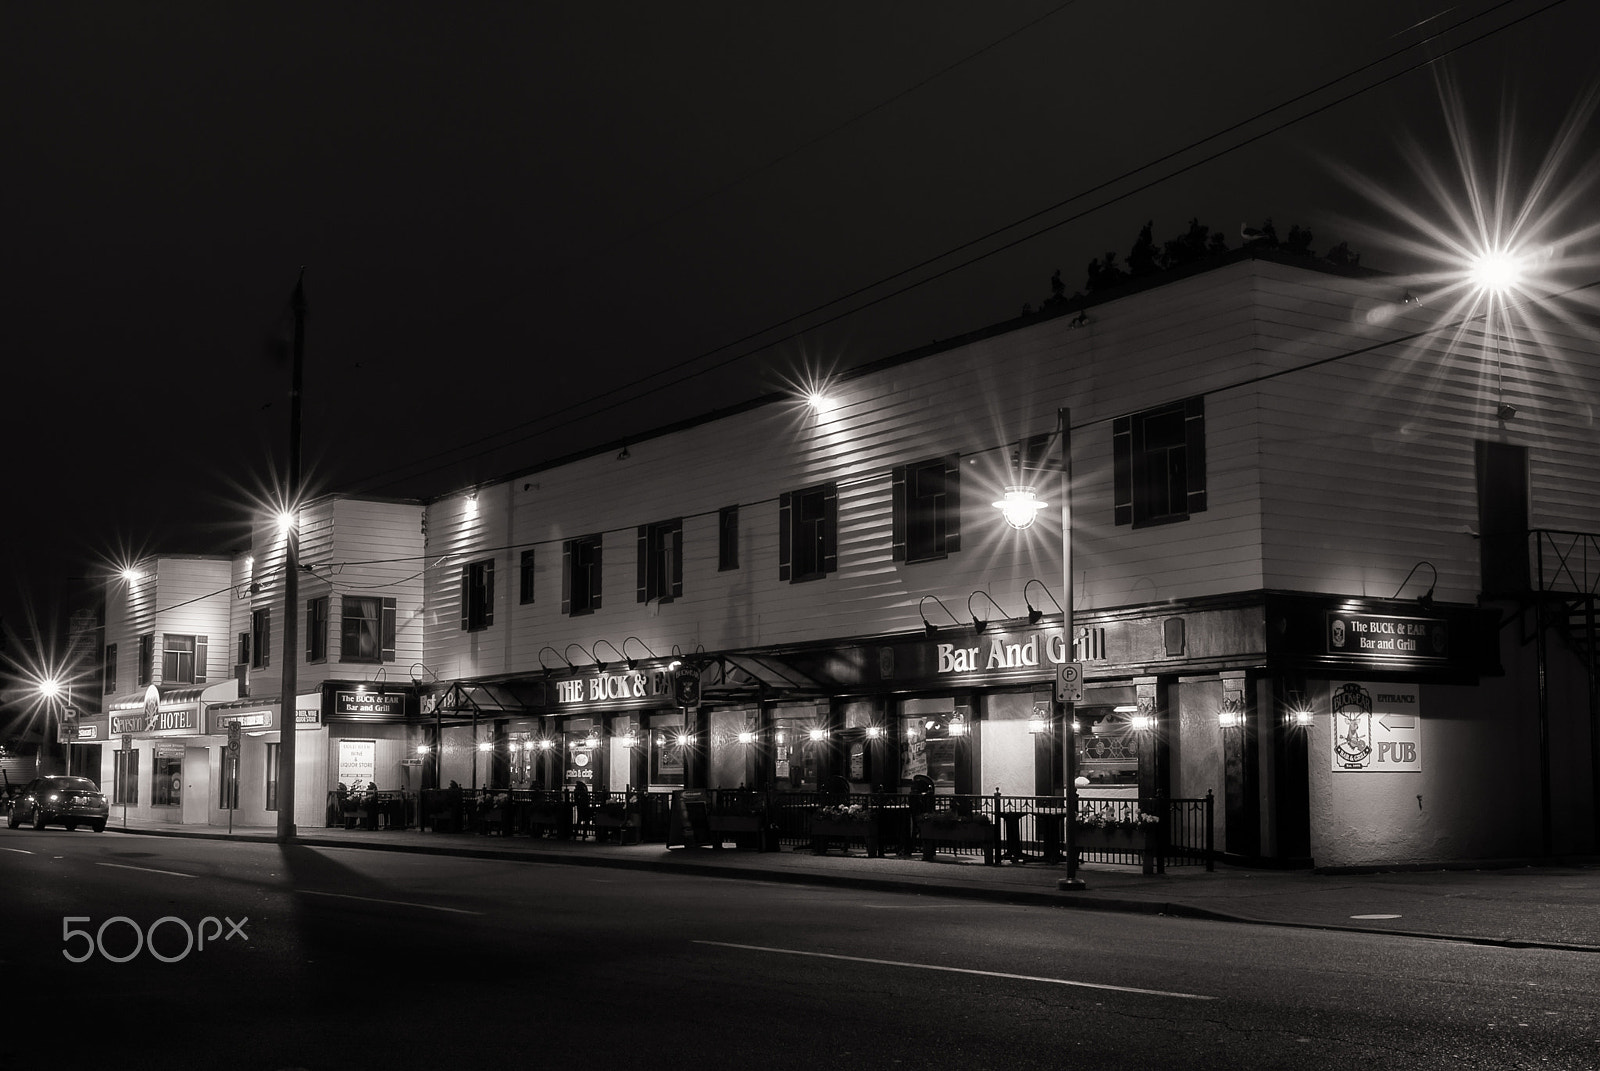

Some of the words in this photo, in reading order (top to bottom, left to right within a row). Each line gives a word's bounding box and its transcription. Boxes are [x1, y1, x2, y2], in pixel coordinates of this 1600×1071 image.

[1351, 621, 1368, 633] The
[1370, 622, 1396, 634] BUCK
[1397, 623, 1405, 635] &
[1407, 624, 1426, 636] EAR
[1360, 637, 1376, 649] Bar
[1377, 639, 1395, 650] and
[1397, 639, 1416, 651] Grill
[937, 643, 979, 673] Bar
[985, 634, 1040, 670] And
[1066, 669, 1074, 679] P
[556, 679, 584, 704] THE
[589, 673, 632, 701] BUCK
[633, 673, 647, 698] &
[652, 671, 675, 696] EA
[342, 695, 355, 703] The
[356, 695, 375, 703] BUCK
[384, 696, 399, 704] EAR
[420, 693, 437, 715] Est
[1377, 694, 1416, 704] ENTRANCE
[64, 708, 77, 722] P
[346, 704, 359, 712] Bar
[360, 704, 373, 712] and
[374, 704, 390, 712] Grill
[160, 711, 192, 730] HOTEL
[1377, 741, 1417, 763] PUB
